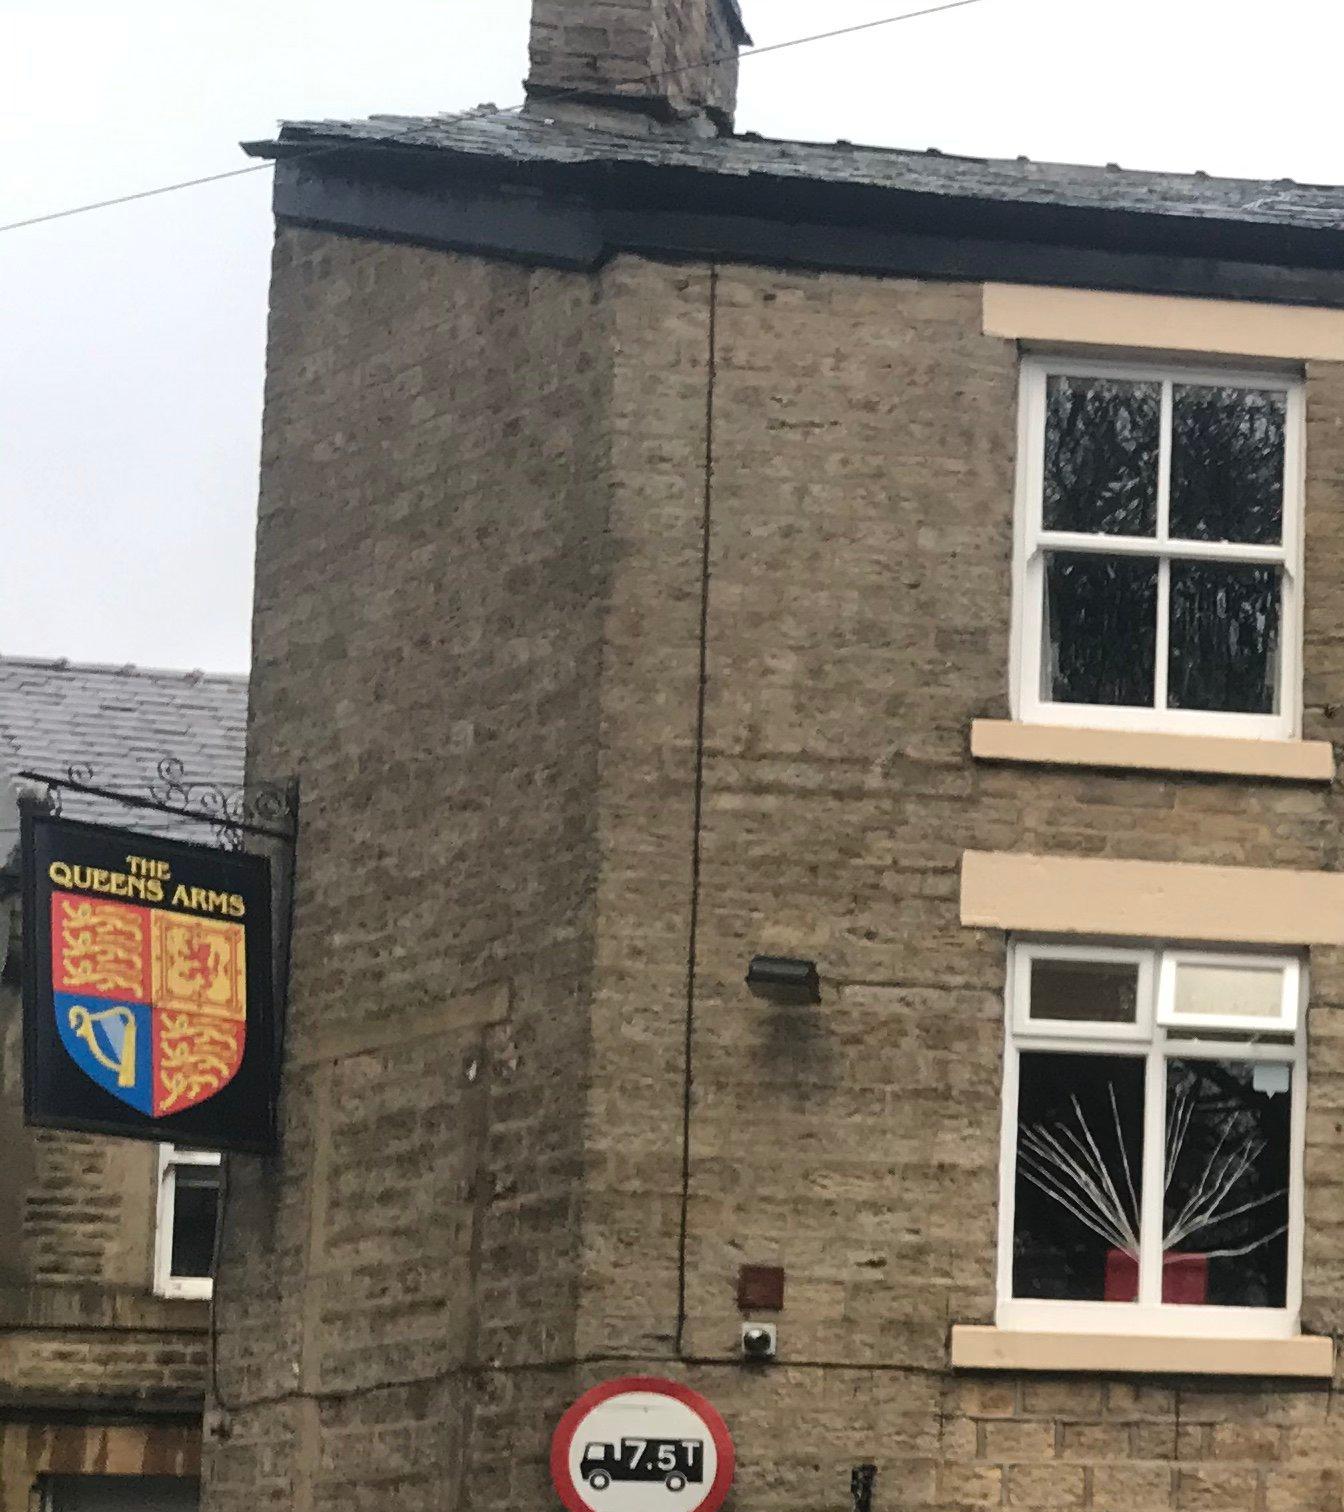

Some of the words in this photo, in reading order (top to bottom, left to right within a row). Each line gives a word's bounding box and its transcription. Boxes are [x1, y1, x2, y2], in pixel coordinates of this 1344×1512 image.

[126, 855, 171, 880] THE
[49, 861, 164, 901] QUEENS
[171, 883, 246, 917] ARMS
[625, 1440, 700, 1470] 7.5T
